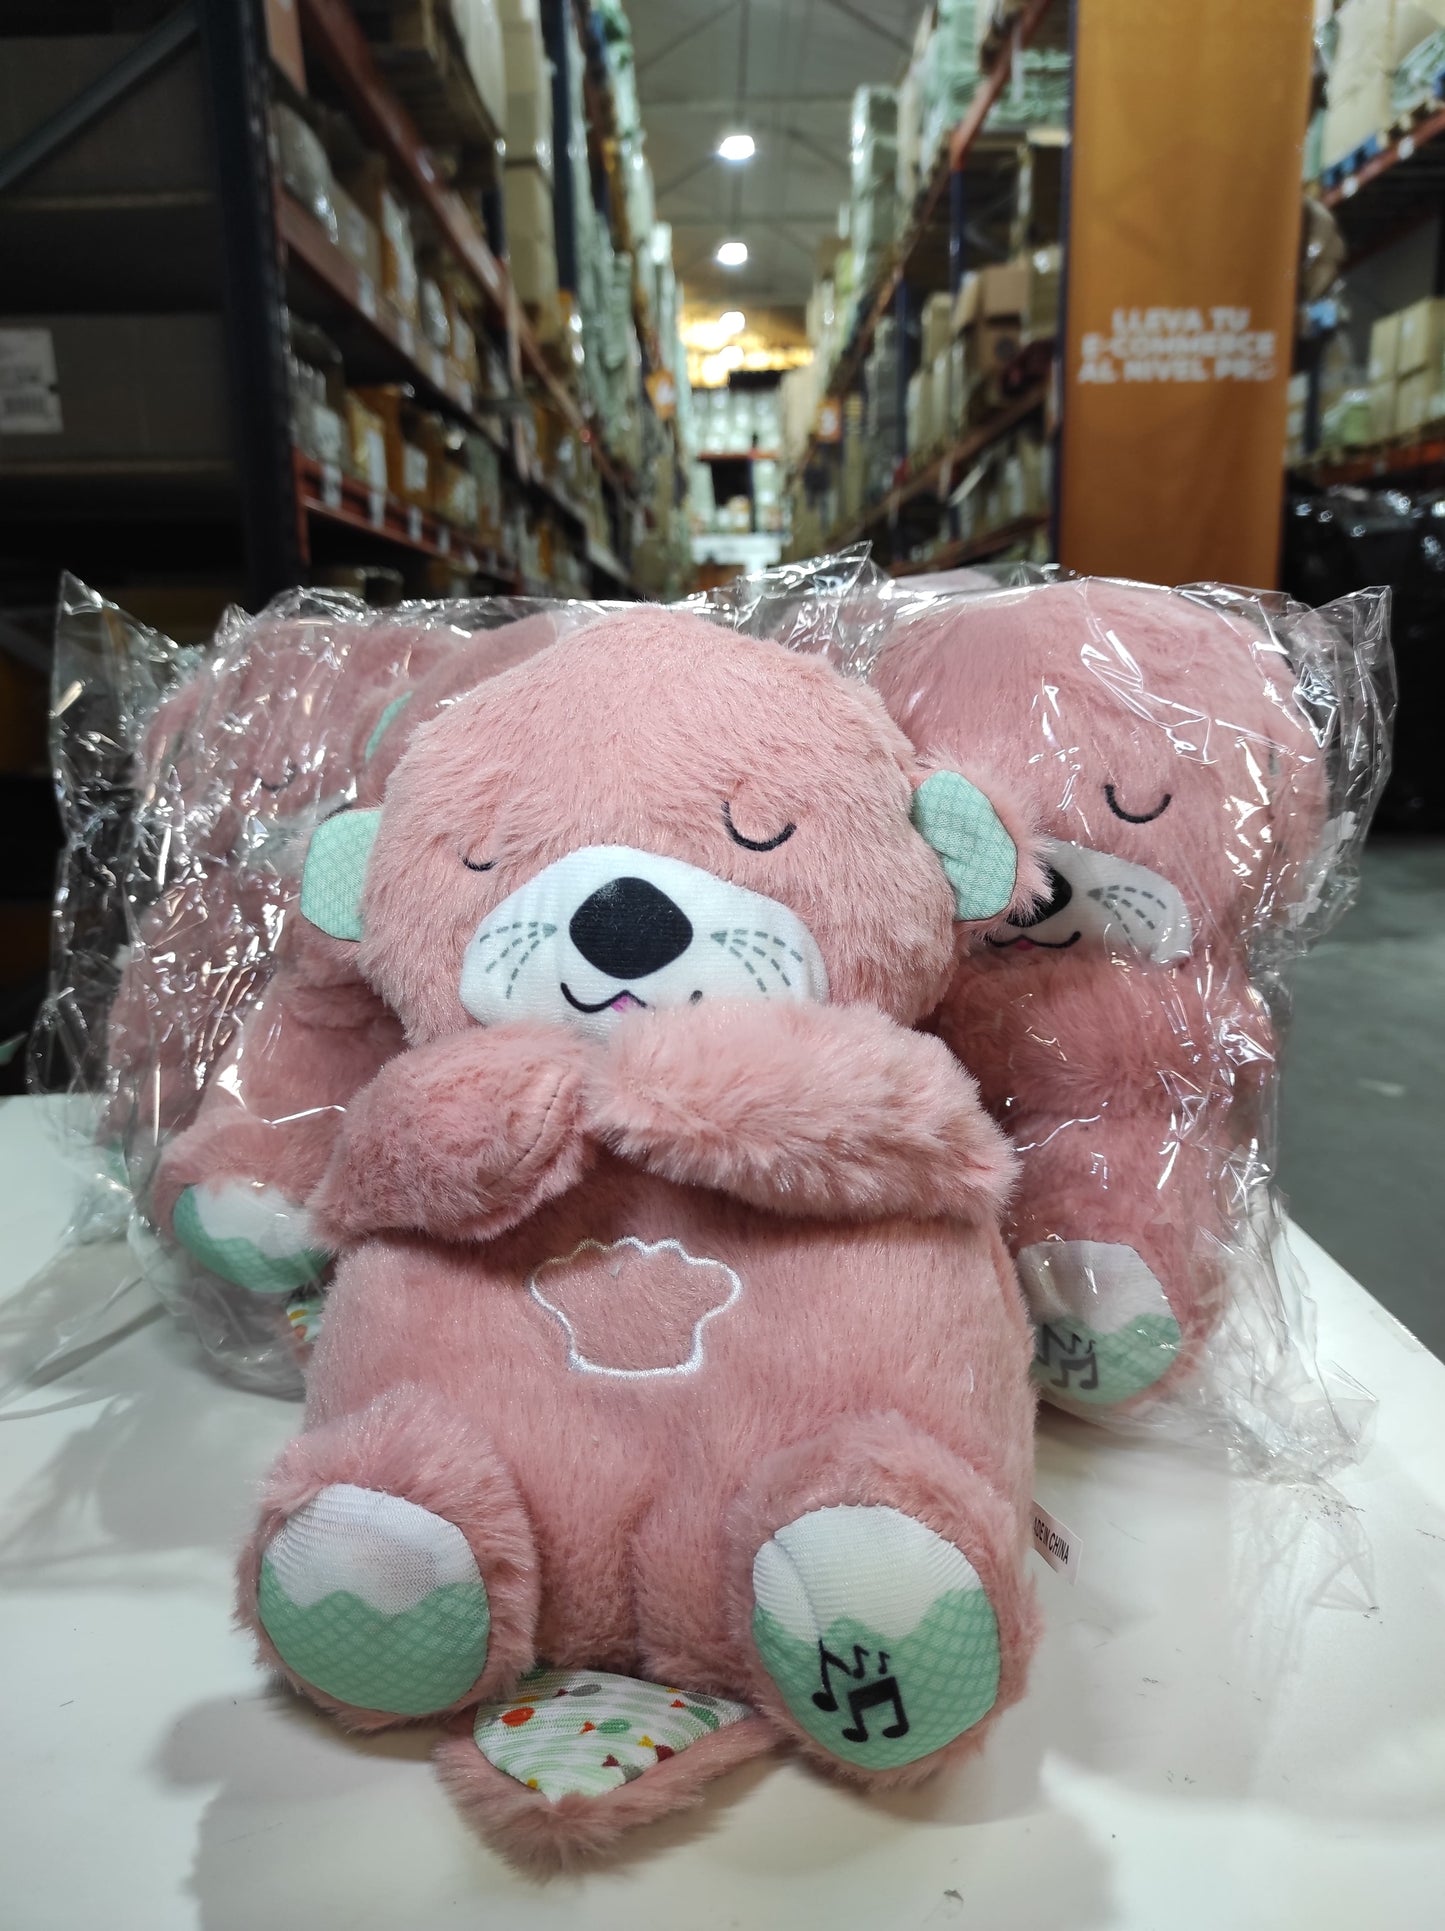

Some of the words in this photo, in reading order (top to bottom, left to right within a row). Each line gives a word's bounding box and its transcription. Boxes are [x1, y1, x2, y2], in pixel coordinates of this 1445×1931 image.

[1111, 307, 1203, 332] LLEVA
[1210, 306, 1251, 330] TU
[1081, 332, 1275, 360] E-COMMERCE
[1078, 361, 1117, 384] AL
[1123, 359, 1209, 383] NIVEL
[1048, 1532, 1070, 1565] CHINA
